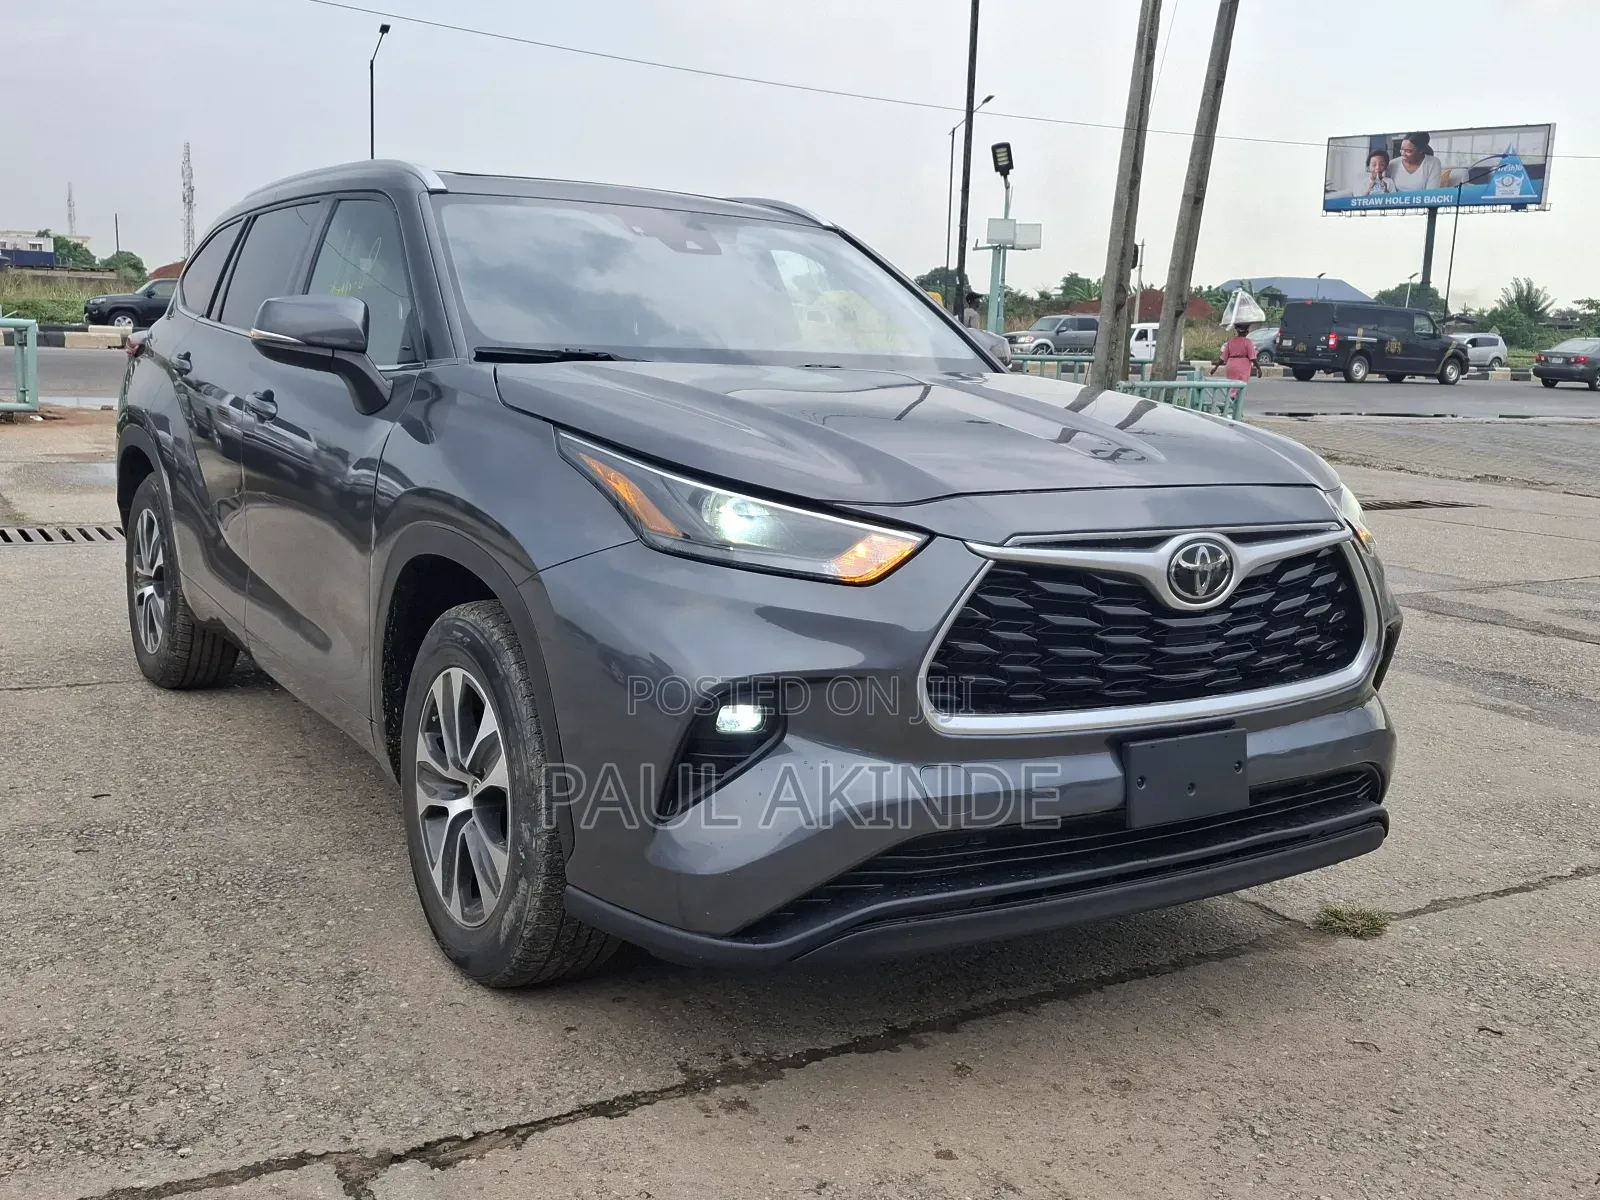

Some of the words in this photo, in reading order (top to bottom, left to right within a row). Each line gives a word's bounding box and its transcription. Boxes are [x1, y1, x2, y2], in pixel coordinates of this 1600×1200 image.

[1351, 197, 1384, 206] STRAW
[1385, 196, 1411, 205] HOLE
[1412, 195, 1422, 204] IS
[1424, 194, 1453, 203] BACK!
